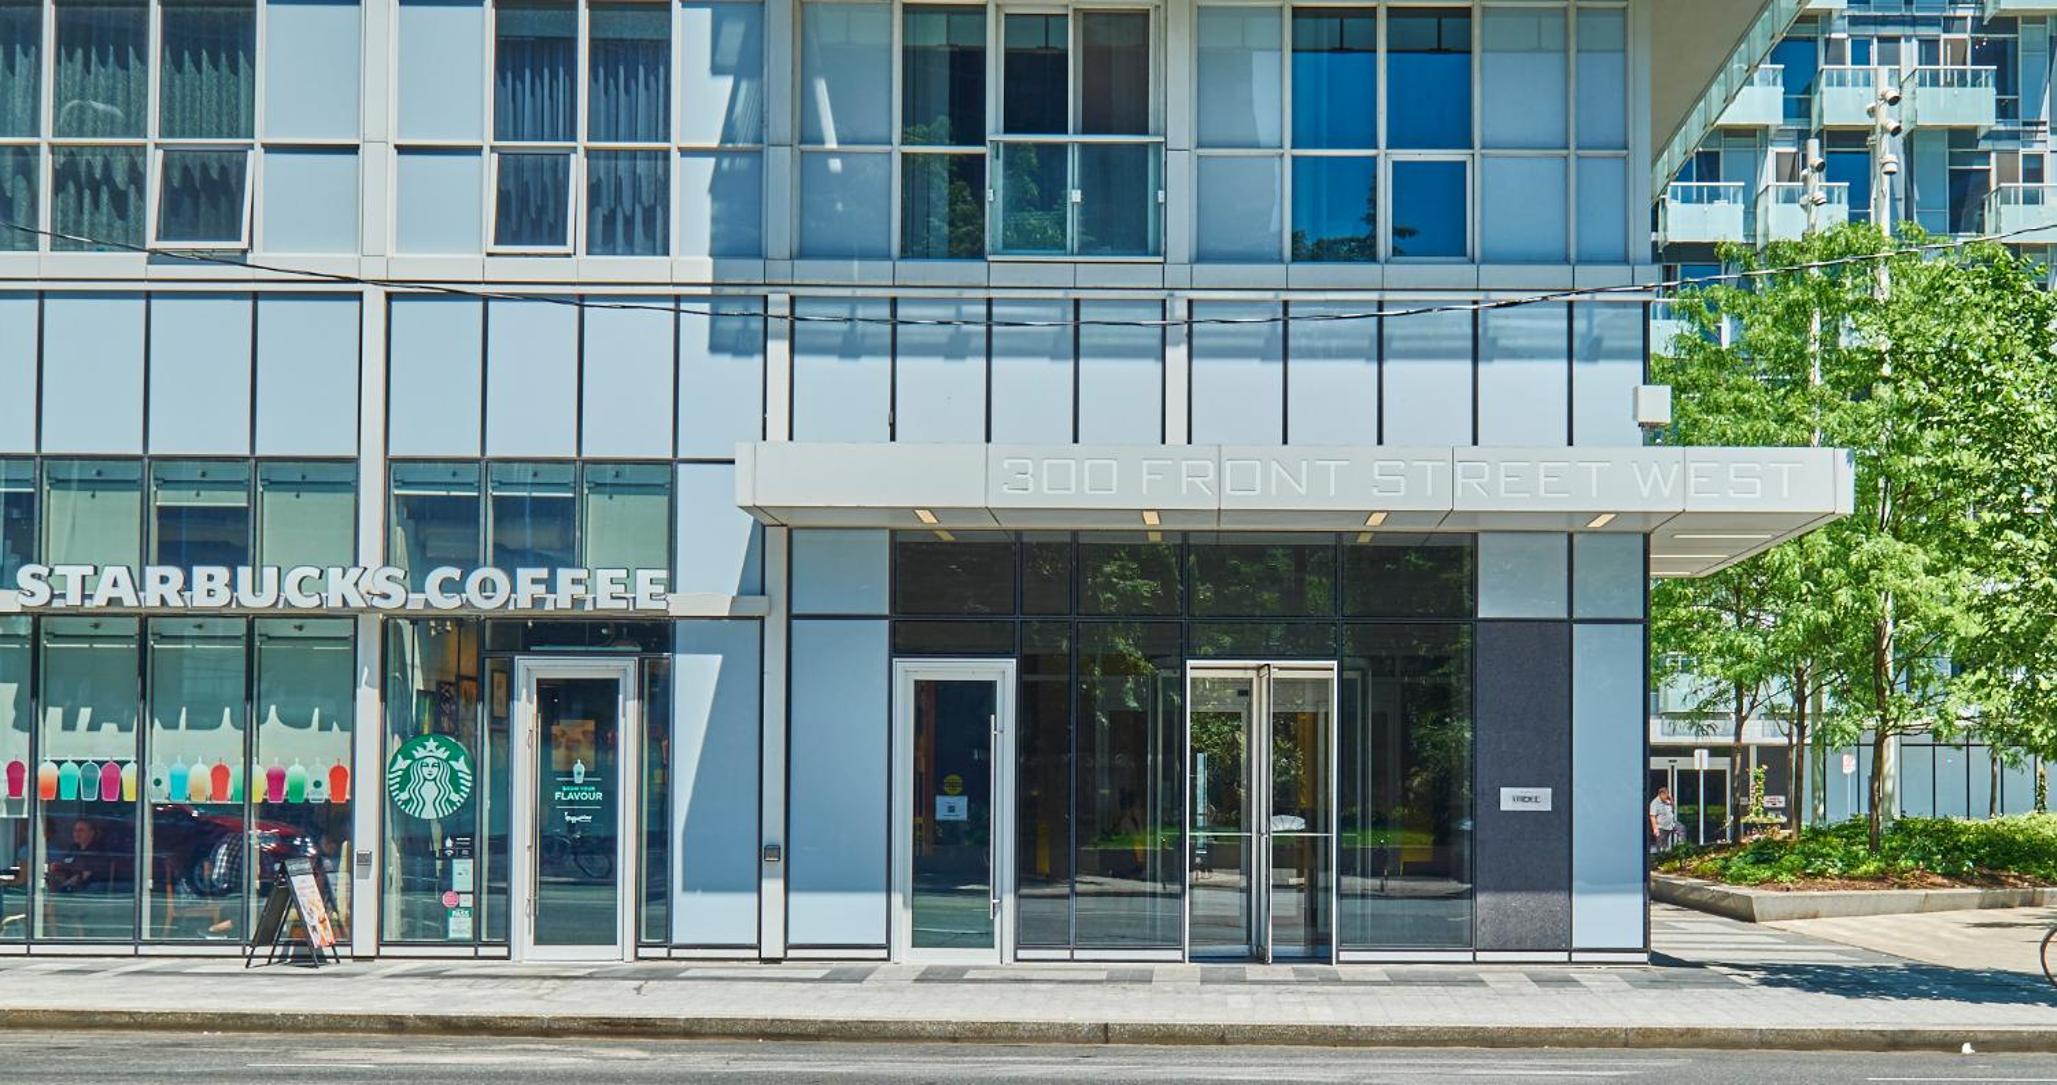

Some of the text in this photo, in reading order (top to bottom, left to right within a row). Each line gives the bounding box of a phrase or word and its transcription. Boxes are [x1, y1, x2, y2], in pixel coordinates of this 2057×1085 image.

[1002, 457, 1804, 499] 300 FRONT STREET WEST
[16, 562, 669, 610] STARBUCKS COFFEE
[554, 791, 603, 801] FLAVOUR
